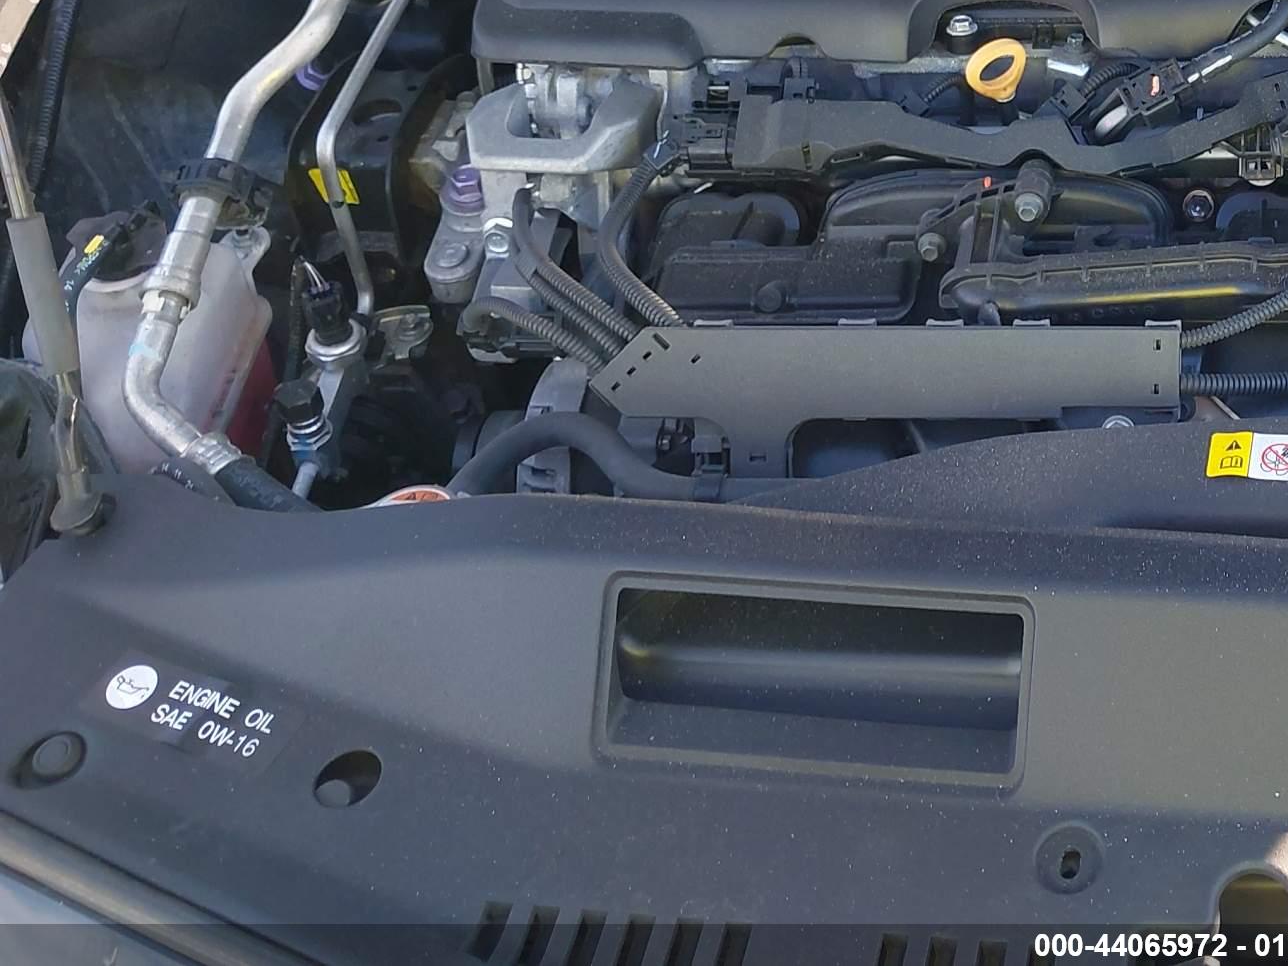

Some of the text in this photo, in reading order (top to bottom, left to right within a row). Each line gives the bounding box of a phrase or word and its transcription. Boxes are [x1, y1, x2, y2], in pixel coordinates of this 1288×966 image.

[151, 704, 260, 757] SAE 0W-16
[168, 680, 275, 735] ENGINE OIL
